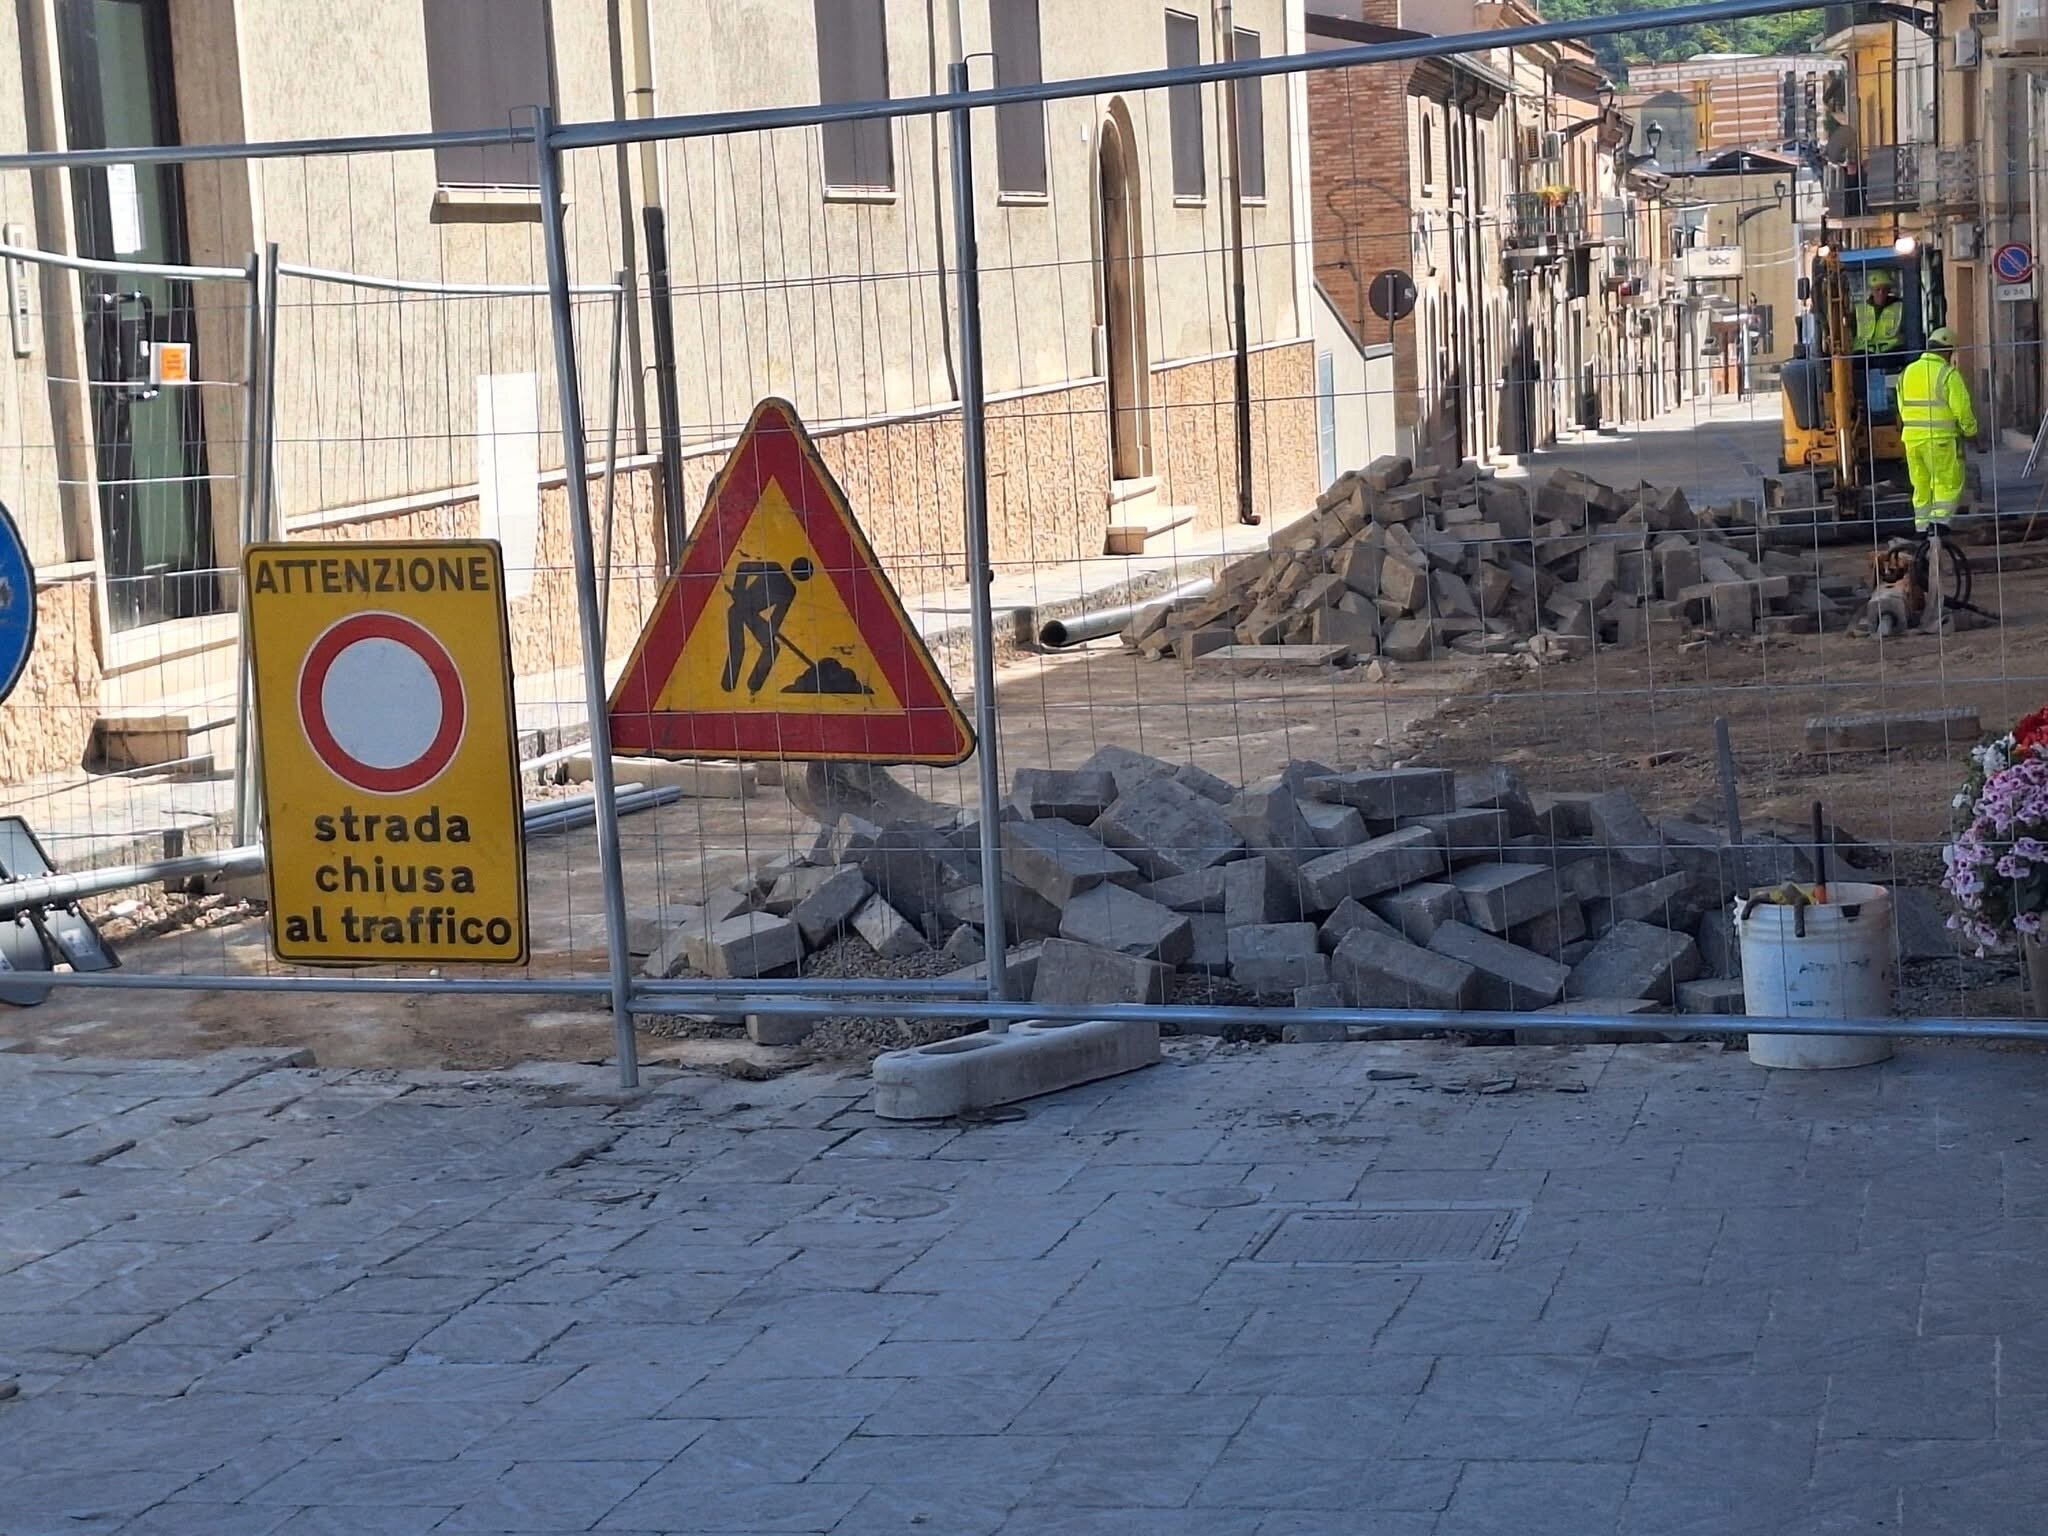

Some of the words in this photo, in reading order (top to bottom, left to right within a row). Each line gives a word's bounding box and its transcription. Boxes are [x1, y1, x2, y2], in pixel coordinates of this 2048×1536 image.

[255, 557, 490, 593] ATTENZIONE
[314, 806, 471, 842] strada
[315, 856, 475, 893] chiusa
[286, 906, 328, 943] al
[341, 907, 512, 946] traffico
